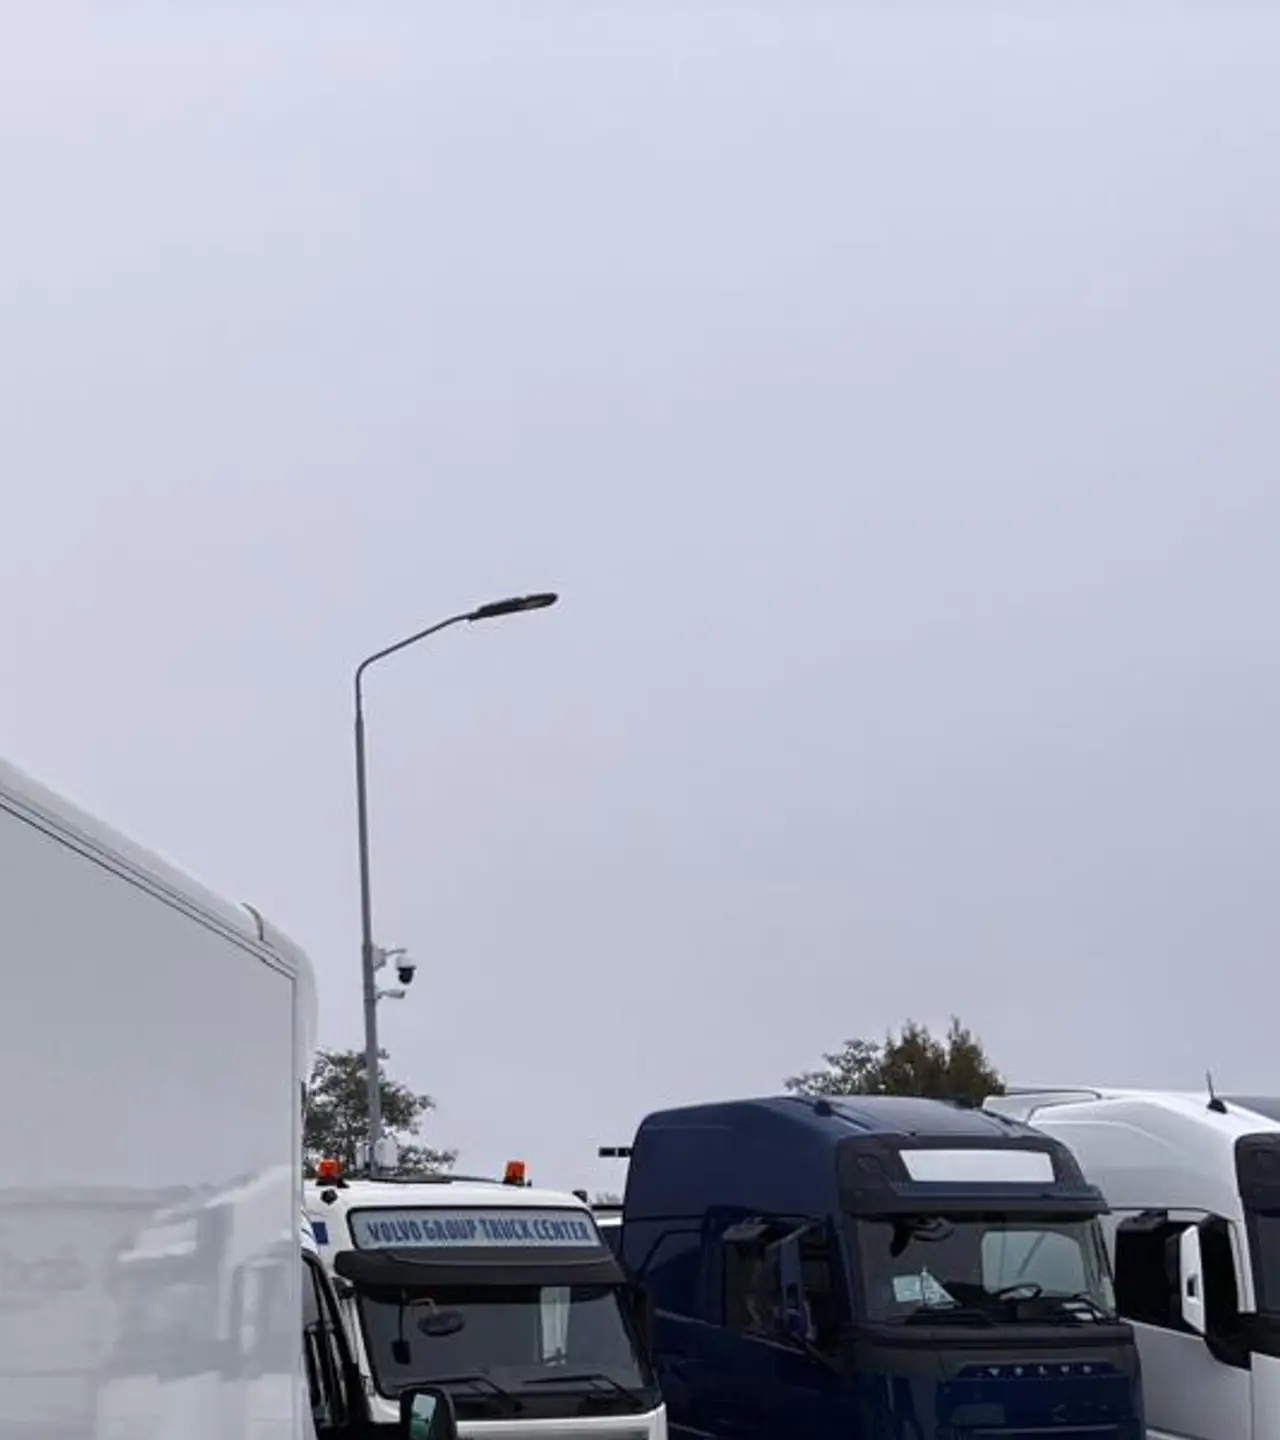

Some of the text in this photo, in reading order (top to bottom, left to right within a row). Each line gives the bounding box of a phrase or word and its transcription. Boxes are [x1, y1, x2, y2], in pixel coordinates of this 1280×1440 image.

[367, 1218, 590, 1242] VOLVO GROUP TRUCK CENTER
